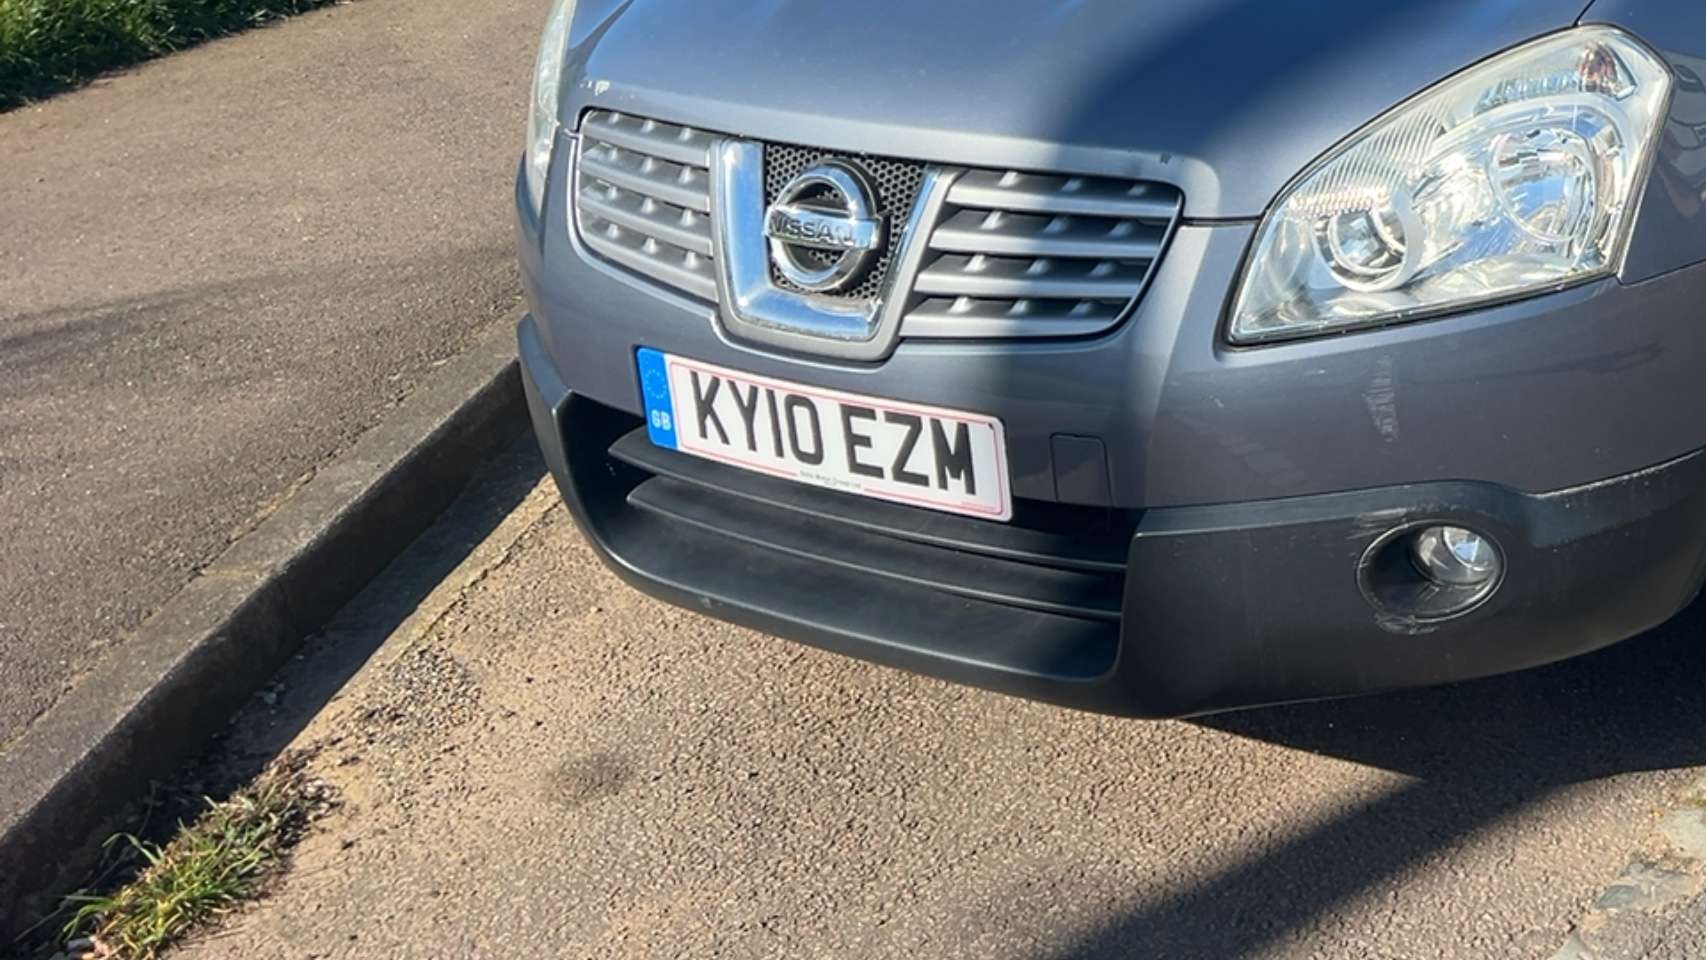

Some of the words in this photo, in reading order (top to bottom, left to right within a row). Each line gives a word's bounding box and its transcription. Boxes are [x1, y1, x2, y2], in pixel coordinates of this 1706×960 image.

[769, 210, 853, 245] NISSAN
[651, 409, 671, 431] GB
[690, 371, 824, 465] KY10
[838, 403, 977, 496] EZM
